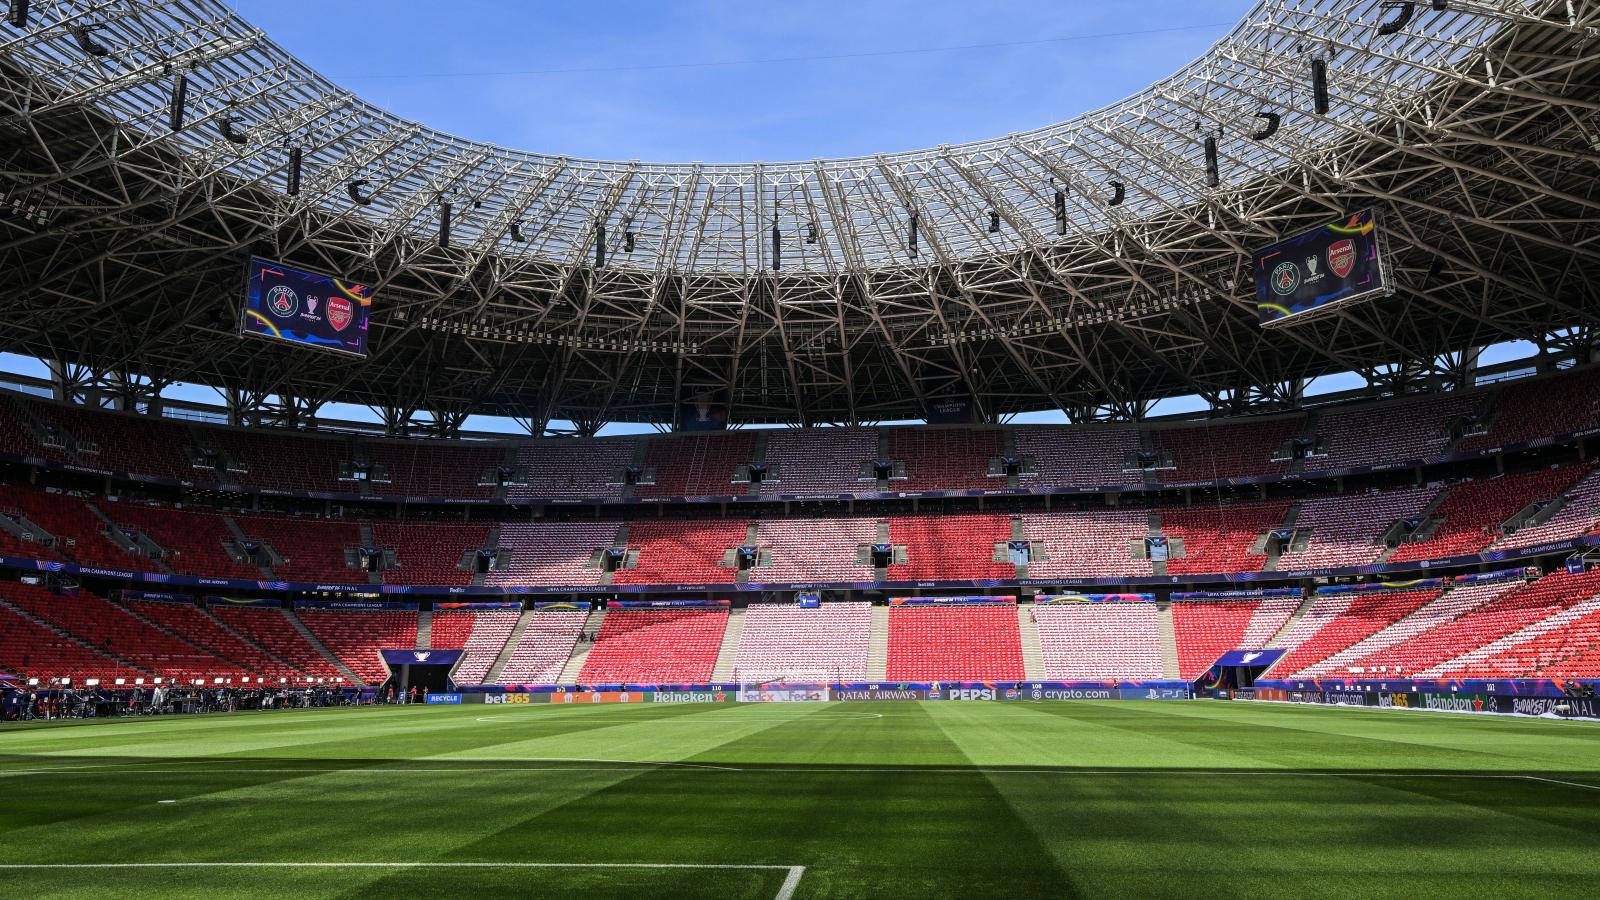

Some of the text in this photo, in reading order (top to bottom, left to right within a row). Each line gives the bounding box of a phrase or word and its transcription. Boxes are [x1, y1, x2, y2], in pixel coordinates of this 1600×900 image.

[1330, 244, 1352, 255] Arsenal
[1274, 264, 1293, 274] PARIS
[274, 287, 294, 298] PARIS
[329, 302, 350, 310] Arsenal
[1532, 545, 1556, 553] CHAMPIONS
[485, 693, 530, 704] bet365
[654, 692, 713, 702] Heineken
[837, 691, 916, 700] QATAR AIRWAYS
[950, 689, 996, 700] PEPSI
[1045, 690, 1110, 700] crypto.com
[1332, 692, 1363, 704] crypto.com
[1378, 692, 1408, 707] bet365
[1424, 693, 1472, 711] Heineken
[1513, 698, 1546, 714] BUDAPEST
[1547, 699, 1556, 714] 26
